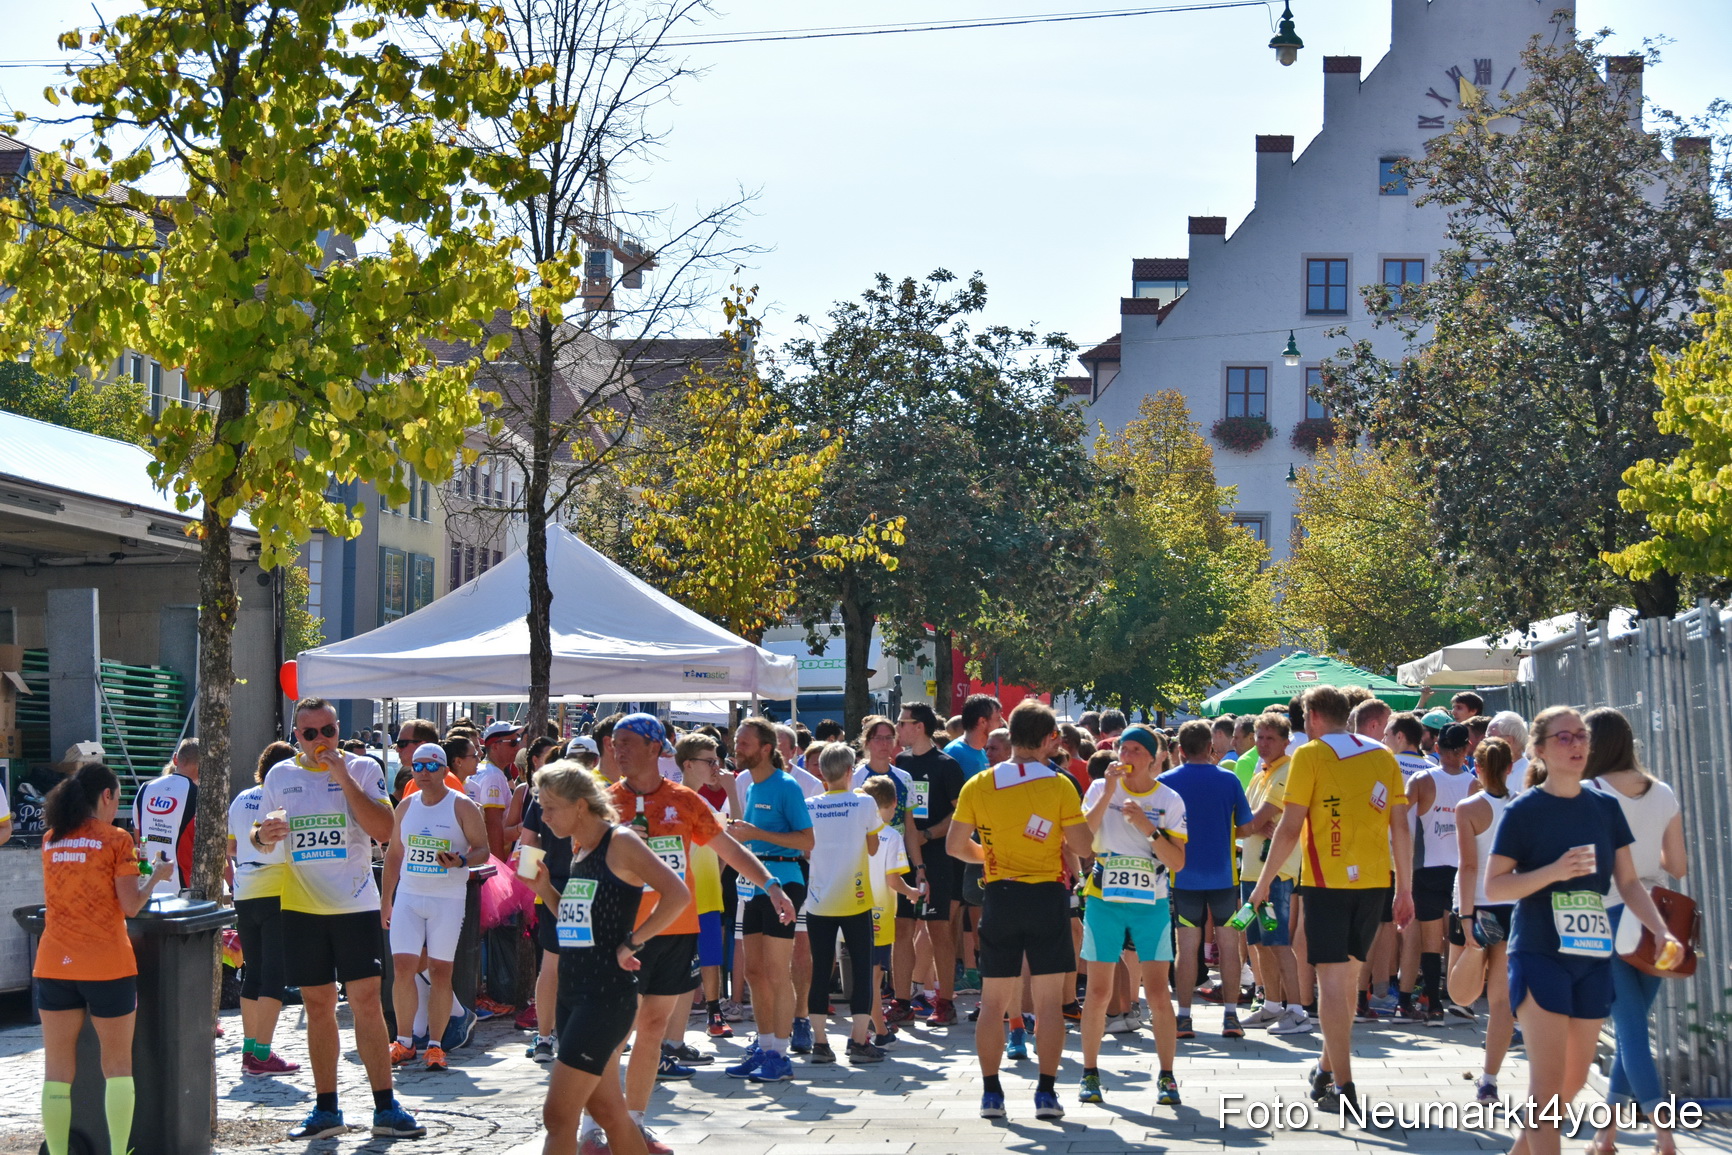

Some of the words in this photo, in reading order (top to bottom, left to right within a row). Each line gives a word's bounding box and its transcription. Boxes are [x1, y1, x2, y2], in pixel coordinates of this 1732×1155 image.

[150, 796, 171, 809] tkn
[817, 801, 860, 810] Neumarkter
[815, 809, 849, 818] Stadtlauf
[292, 815, 343, 829] BOCK
[296, 830, 341, 848] 2349
[52, 851, 86, 863] Coburg
[301, 850, 336, 859] SAMUEL
[410, 849, 437, 863] 235
[412, 865, 438, 873] STEFAN
[1107, 857, 1152, 872] BOCK
[1109, 871, 1150, 888] 2819
[1563, 914, 1606, 934] 2075
[1573, 938, 1605, 949] ANNIKA
